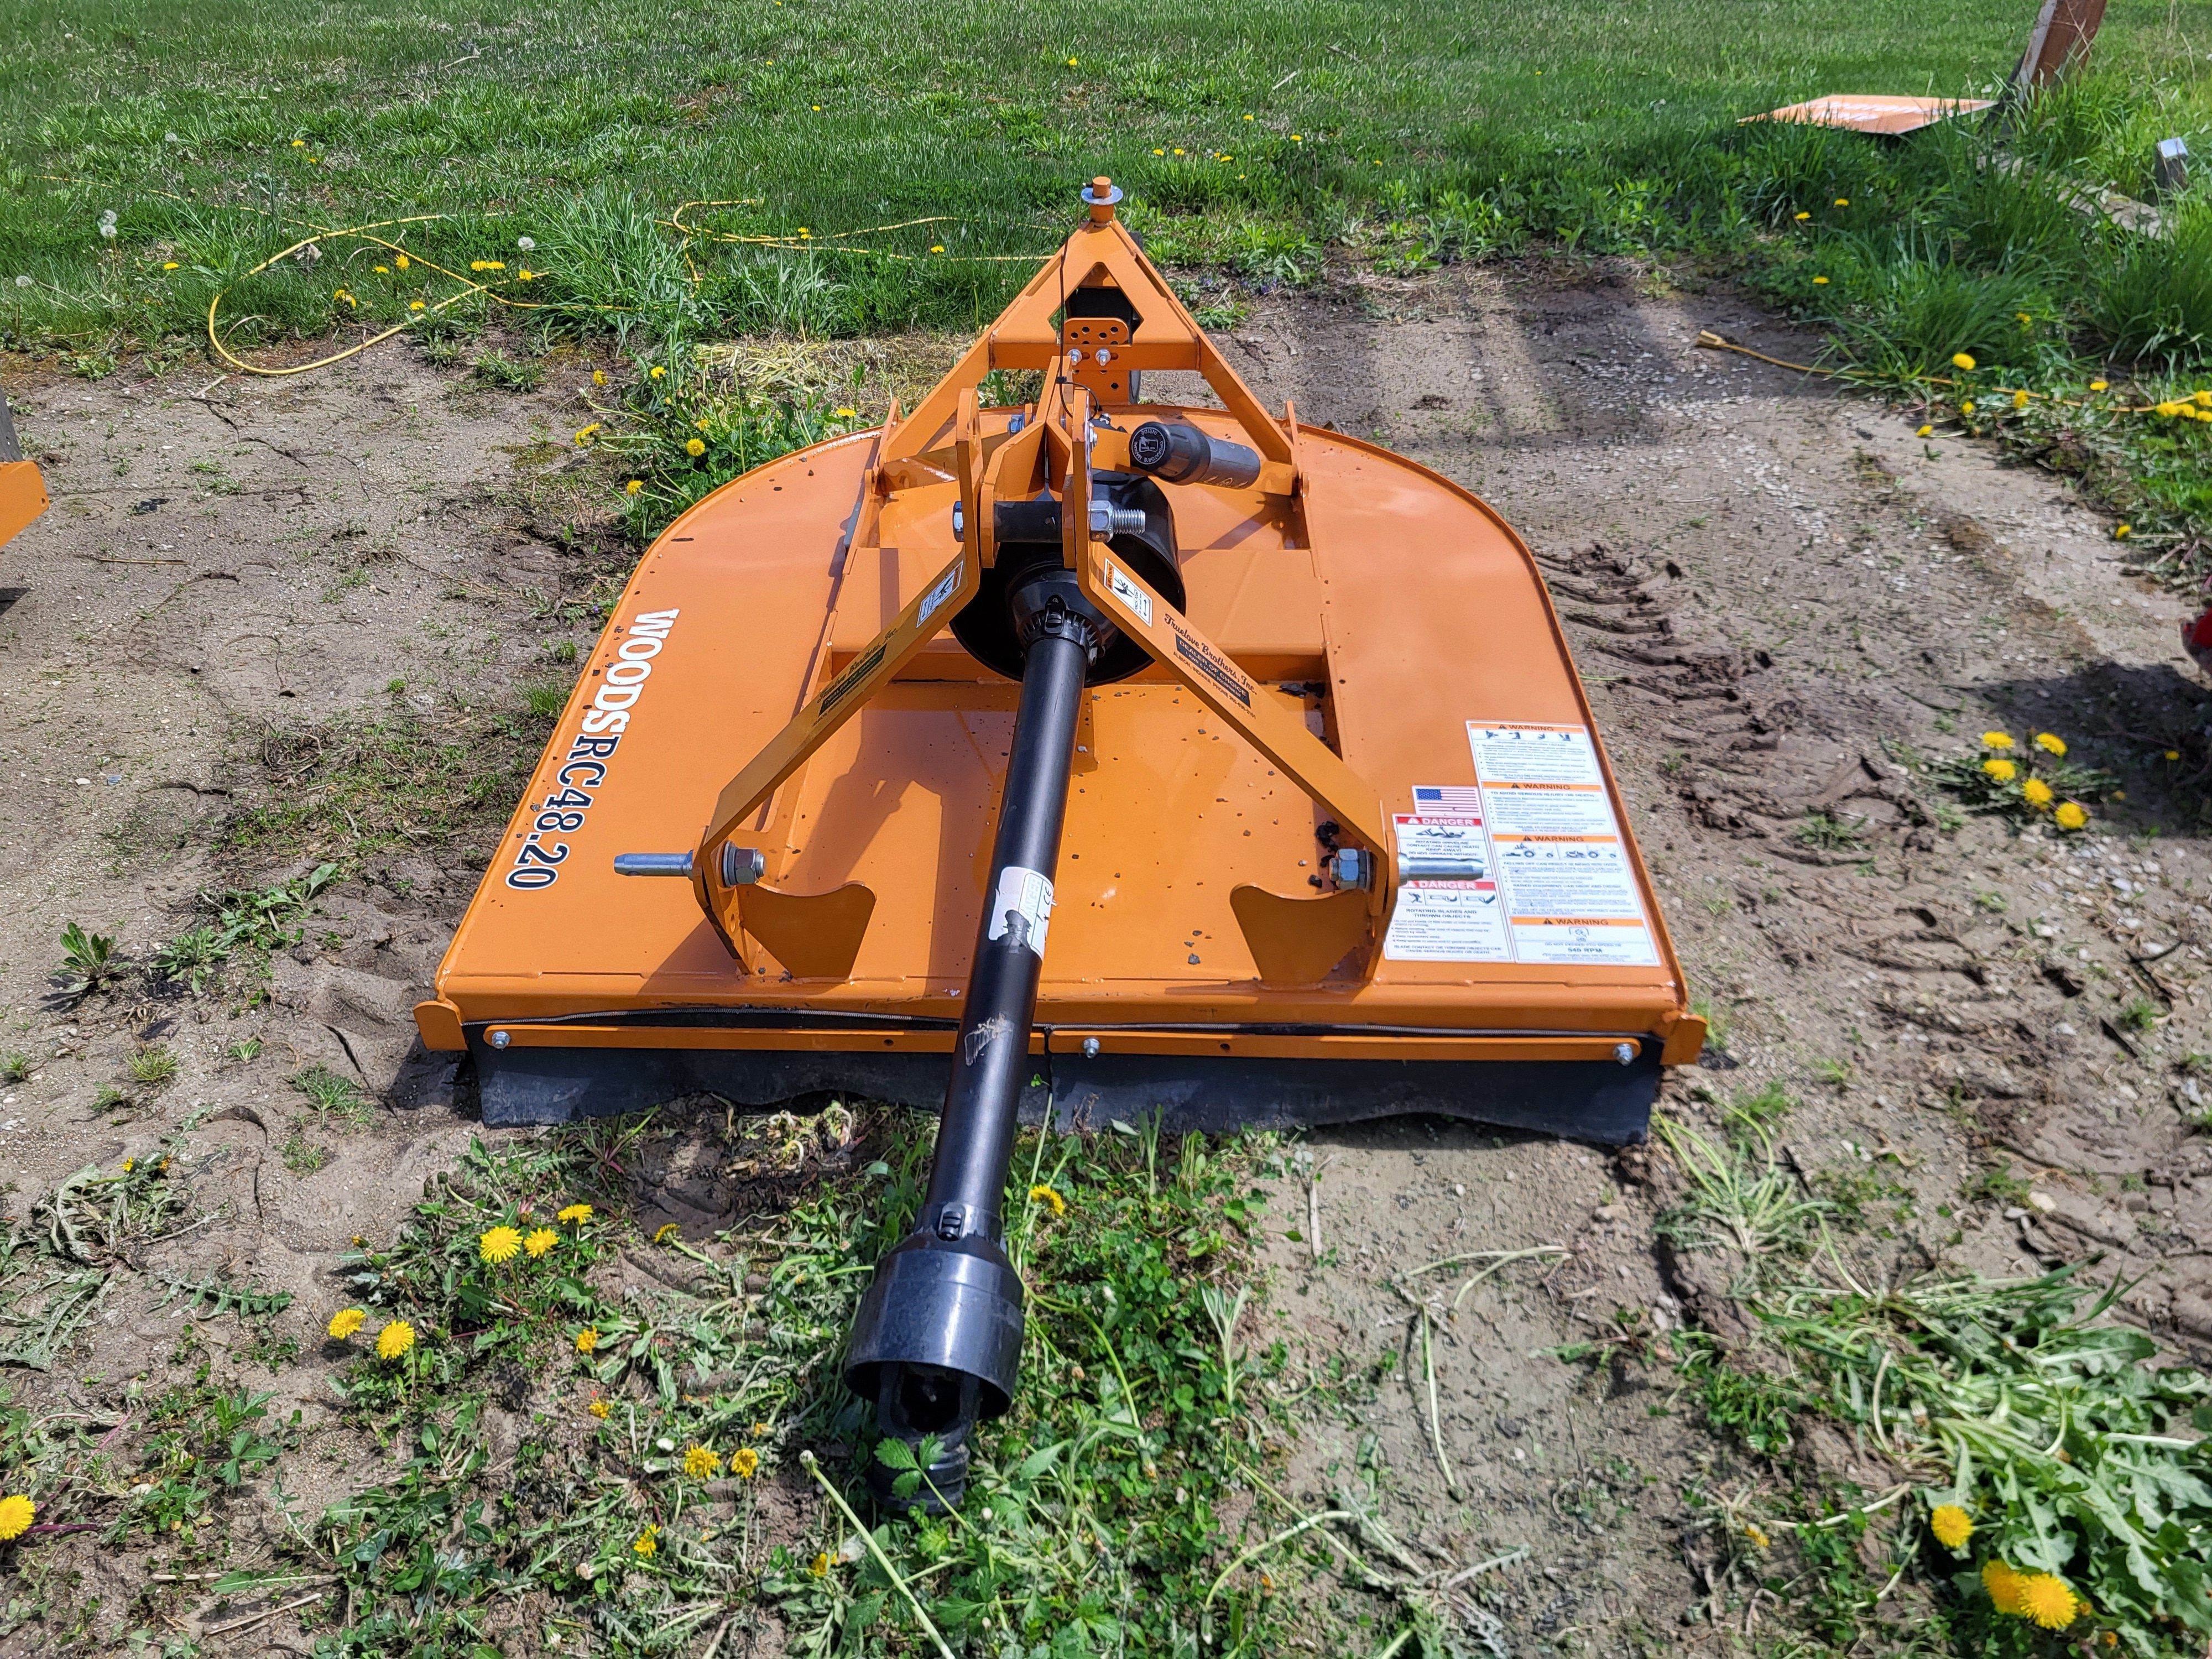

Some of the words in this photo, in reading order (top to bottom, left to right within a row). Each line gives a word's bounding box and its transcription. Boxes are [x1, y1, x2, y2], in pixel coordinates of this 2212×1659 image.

[1133, 441, 1142, 460] MANUAL
[1144, 441, 1164, 462] OPERATOR'S
[581, 608, 680, 734] WOODS
[1164, 613, 1200, 649] Truelove
[1240, 675, 1257, 695] Inc.
[1179, 640, 1208, 665] DEALER
[1209, 664, 1218, 673] OF
[1220, 672, 1246, 697] CHOICE
[505, 733, 623, 890] RC48.20
[1419, 880, 1477, 889] DANGER
